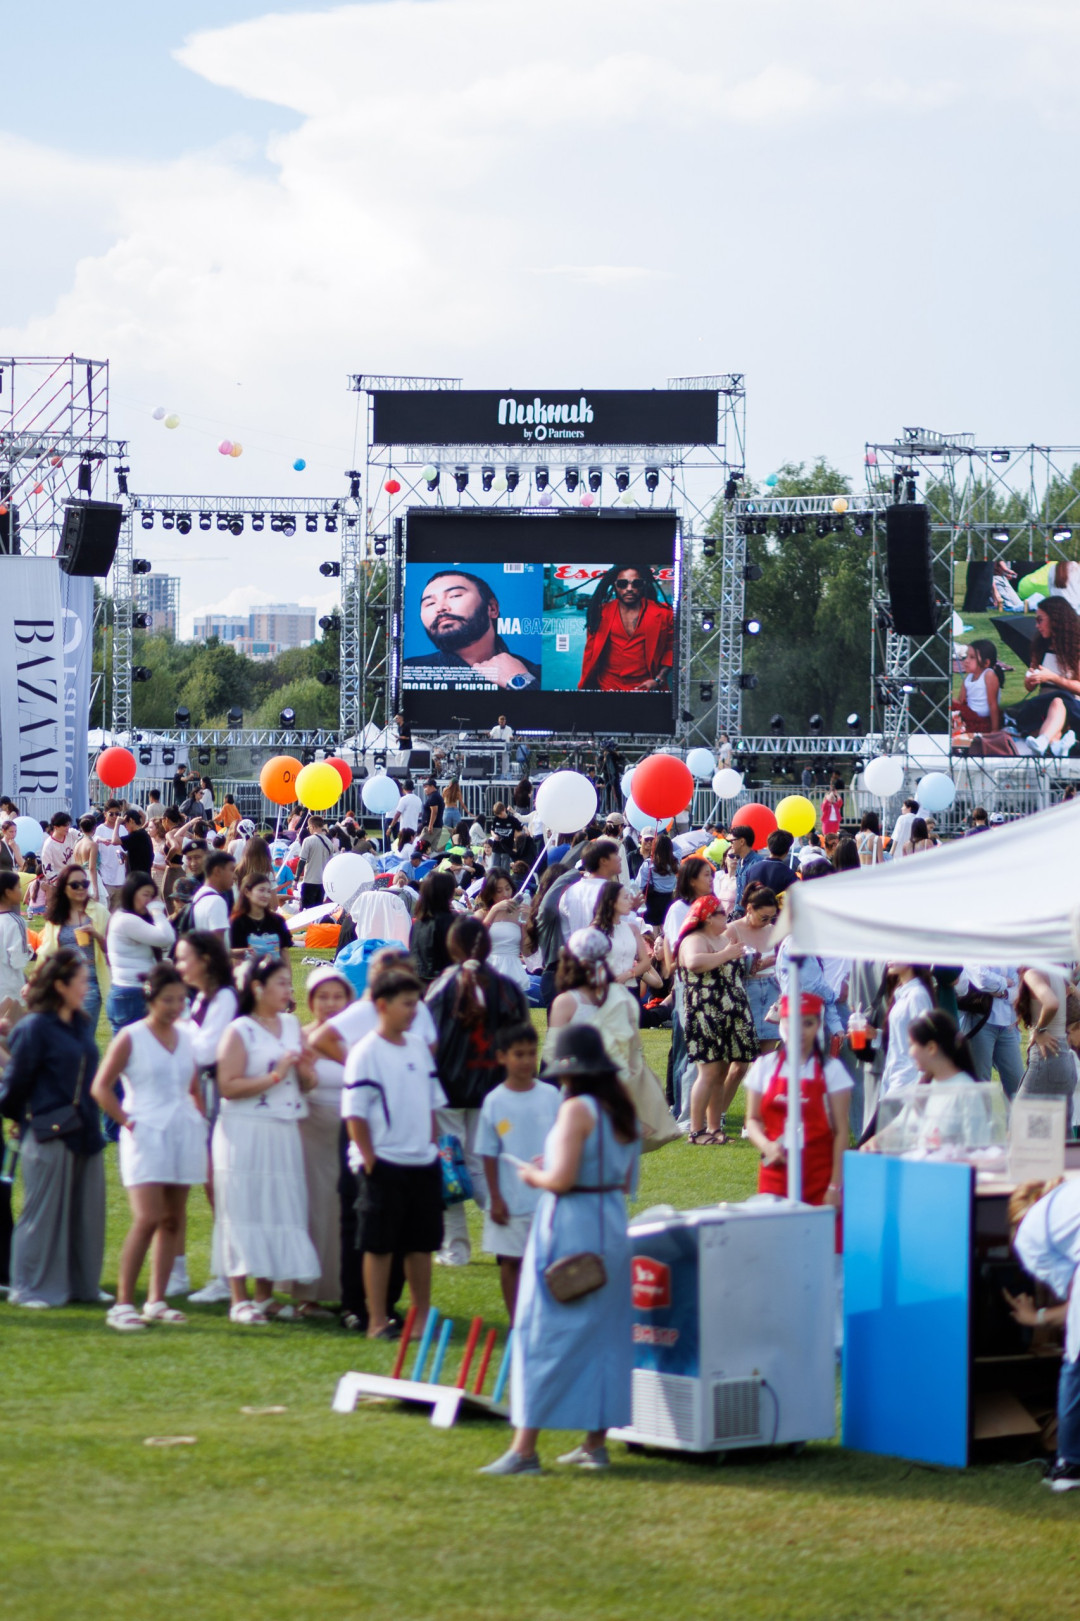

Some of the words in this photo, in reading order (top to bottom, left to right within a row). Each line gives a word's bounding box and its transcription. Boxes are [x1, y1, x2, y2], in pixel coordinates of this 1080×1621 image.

[523, 428, 533, 441] by
[548, 428, 585, 438] Partners
[497, 617, 586, 635] MAGAZINES
[14, 617, 59, 796] BAZAAR
